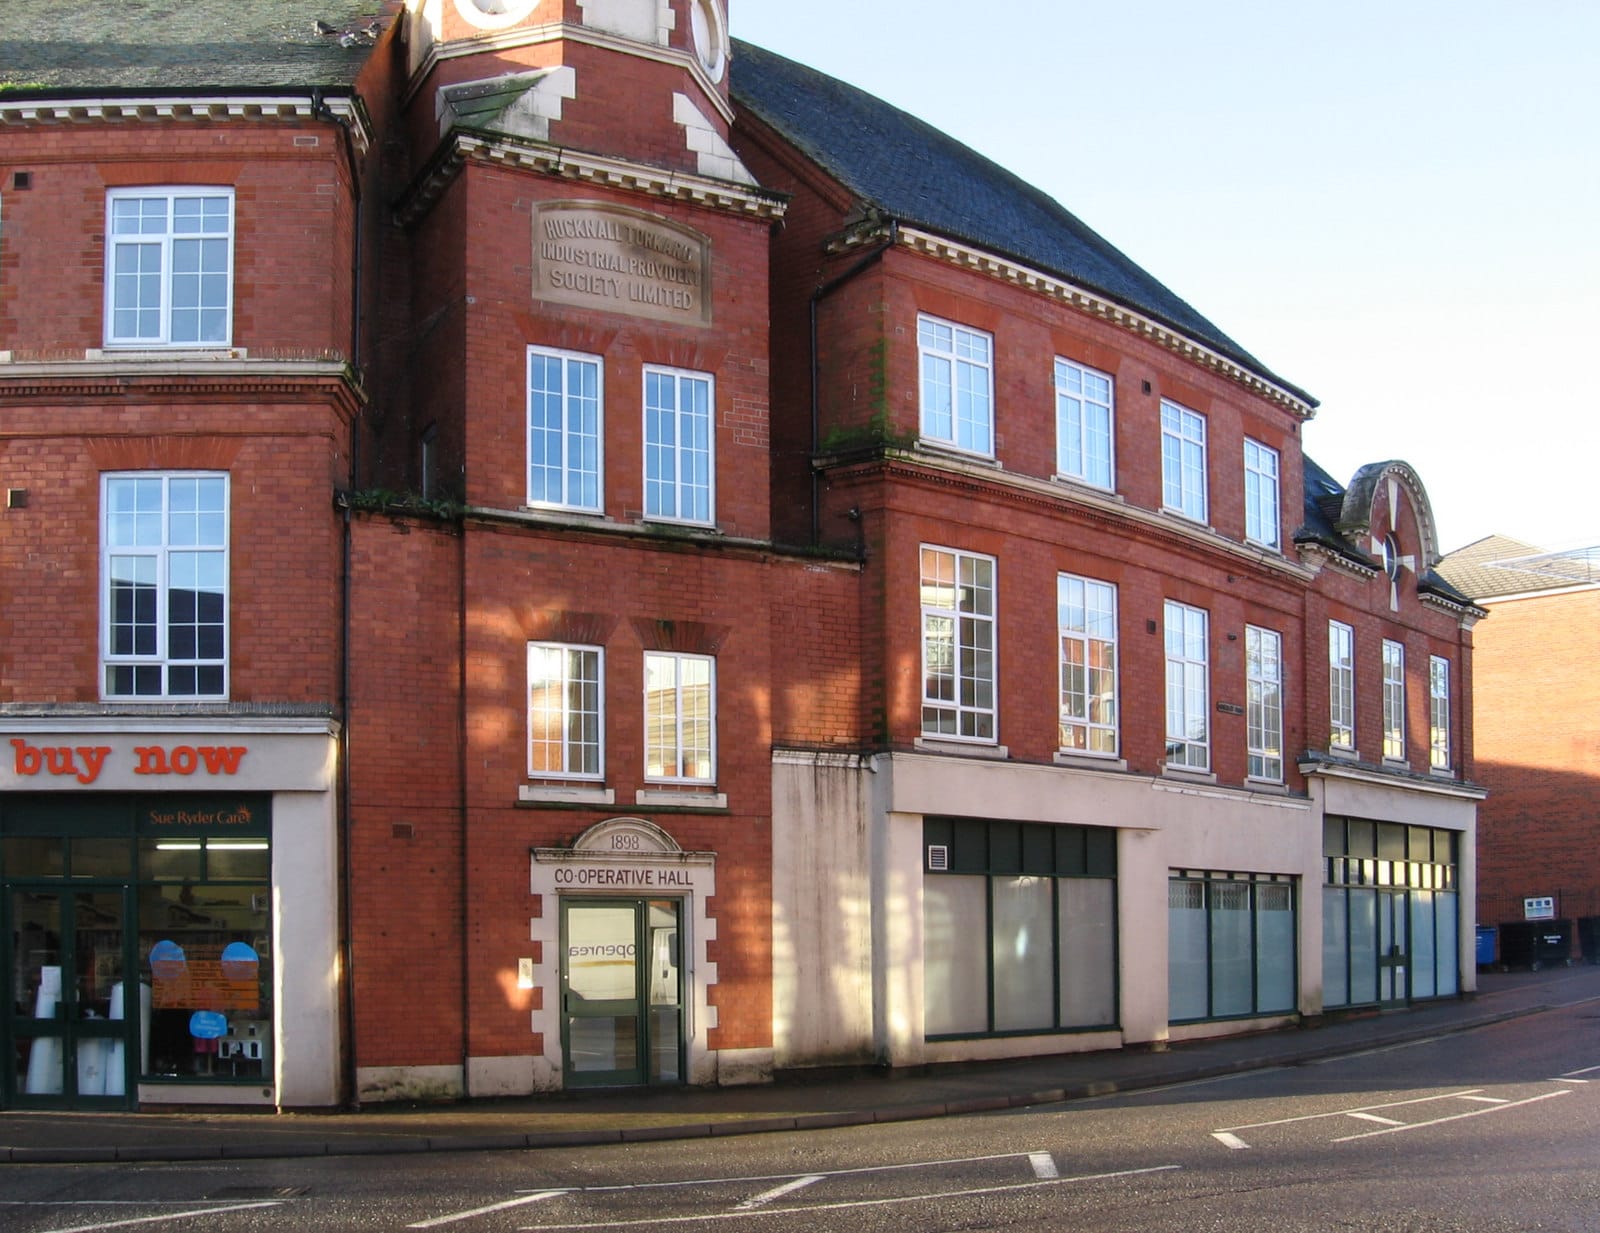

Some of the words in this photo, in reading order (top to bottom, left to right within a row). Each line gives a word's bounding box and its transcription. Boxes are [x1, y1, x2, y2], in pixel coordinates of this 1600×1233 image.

[545, 220, 623, 242] HUCKNALL
[542, 243, 625, 273] INDUSTRIAL
[628, 258, 700, 286] PROVIDENT
[551, 269, 623, 298] SOCIETY
[629, 283, 693, 309] LIMITED
[10, 738, 112, 784] buy
[133, 744, 248, 776] now
[149, 810, 175, 825] Sue
[177, 810, 214, 826] Ryder
[216, 810, 247, 825] Care
[610, 834, 640, 850] 1898
[658, 869, 694, 887] HALL
